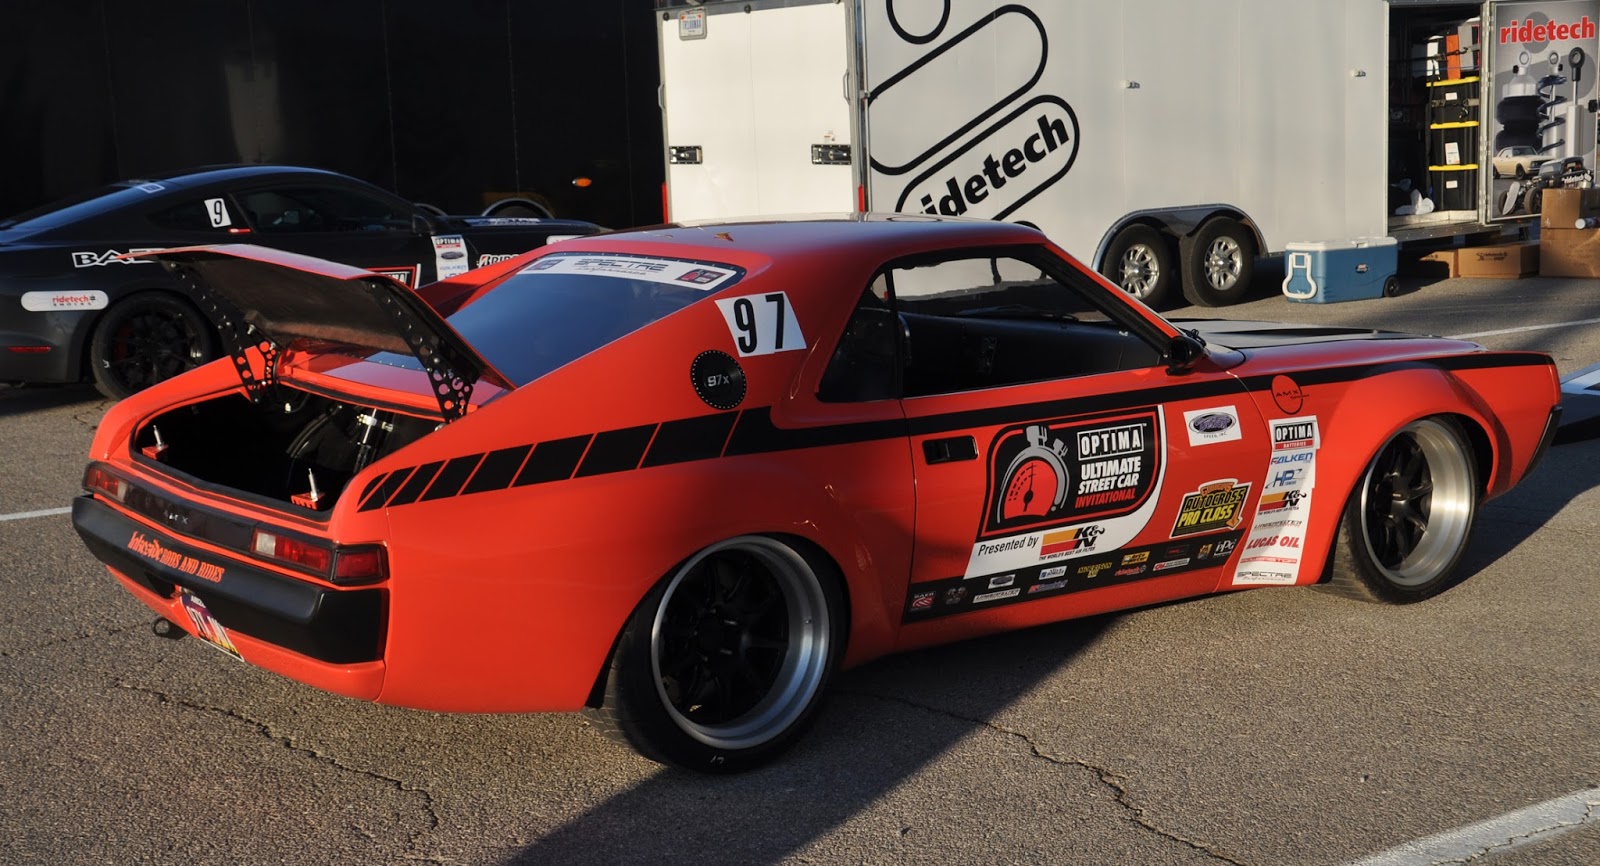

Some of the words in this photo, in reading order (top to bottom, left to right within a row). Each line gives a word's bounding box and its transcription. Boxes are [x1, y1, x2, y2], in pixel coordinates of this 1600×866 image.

[1500, 16, 1595, 44] ridetech
[920, 114, 1069, 216] idetech
[213, 199, 223, 226] 9
[53, 295, 89, 303] ridetech
[733, 293, 785, 354] 97
[1080, 430, 1141, 456] OPTIMA
[1275, 423, 1312, 441] OPTIMA
[1080, 456, 1142, 480] ULTIMATE
[1270, 452, 1313, 465] FALKEN
[1077, 476, 1118, 495] STREET
[1117, 472, 1139, 489] CAR
[1074, 488, 1136, 509] INVITATIONAL
[1185, 489, 1246, 512] AUTOCROSS
[1281, 490, 1307, 507] K&N
[1177, 510, 1200, 529] PRO
[1200, 504, 1235, 525] CLASS
[978, 537, 1027, 556] Presented
[1027, 536, 1039, 549] by
[1073, 525, 1106, 549] K&N
[1246, 535, 1280, 550] LUCAS
[1279, 536, 1300, 548] OIL
[178, 556, 200, 575] AND
[196, 562, 225, 583] RIDES
[1237, 571, 1292, 579] SPECTRE
